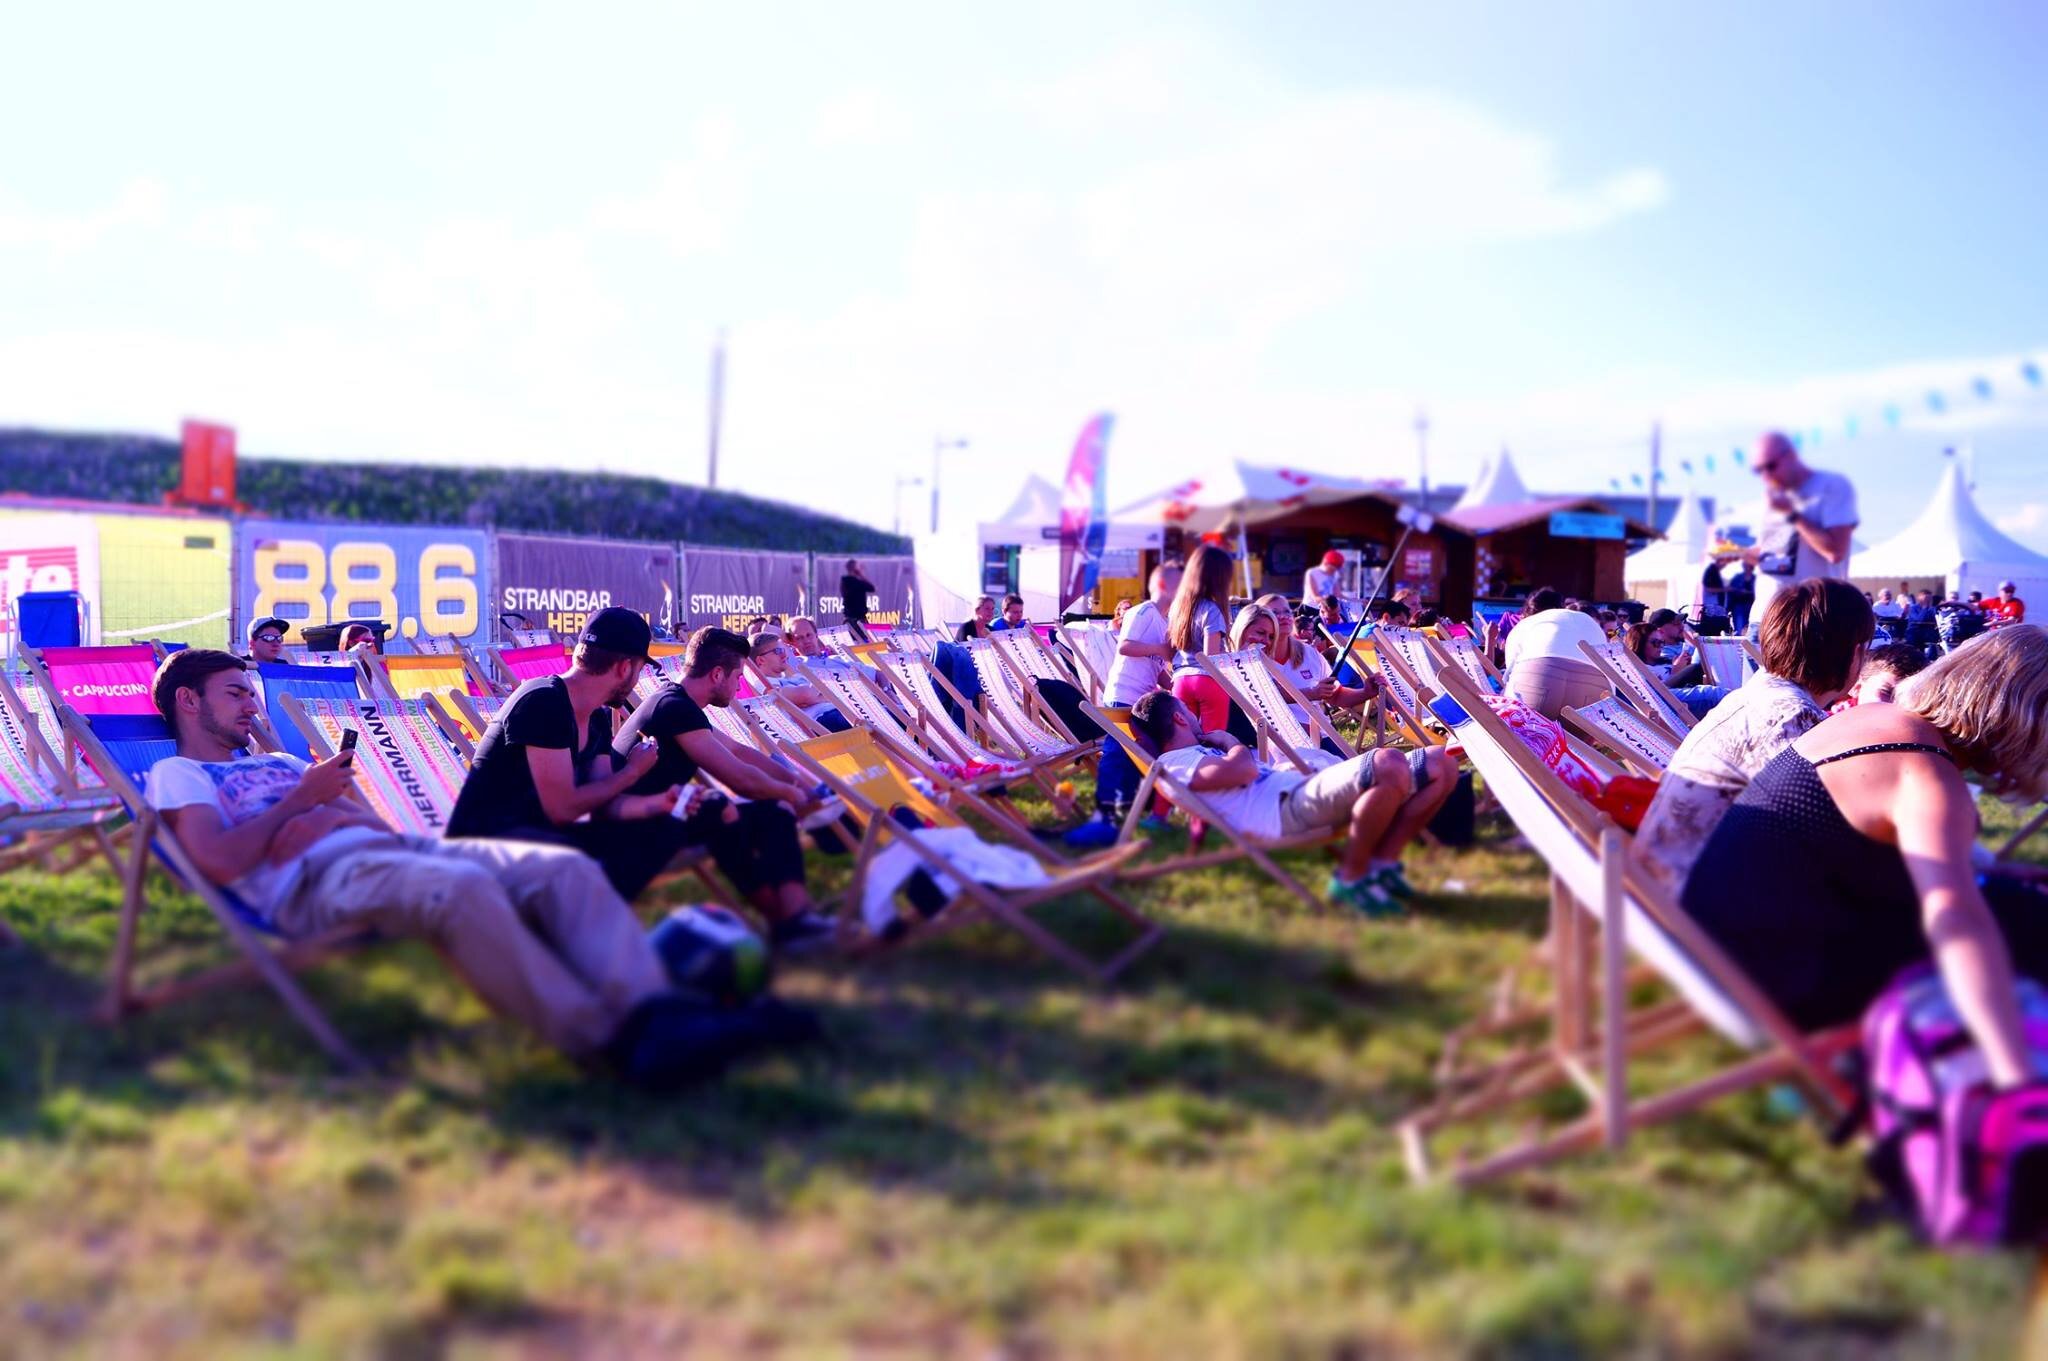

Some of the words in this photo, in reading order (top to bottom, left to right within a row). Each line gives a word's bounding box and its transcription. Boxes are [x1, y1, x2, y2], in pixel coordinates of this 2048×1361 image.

[253, 540, 478, 645] 88.6
[503, 587, 611, 611] STRANDBAR
[691, 594, 764, 614] STRANDBAR
[72, 683, 149, 697] CAPPUCCINO
[1380, 656, 1415, 708] HERRMANN
[360, 705, 444, 828] HERRMANN
